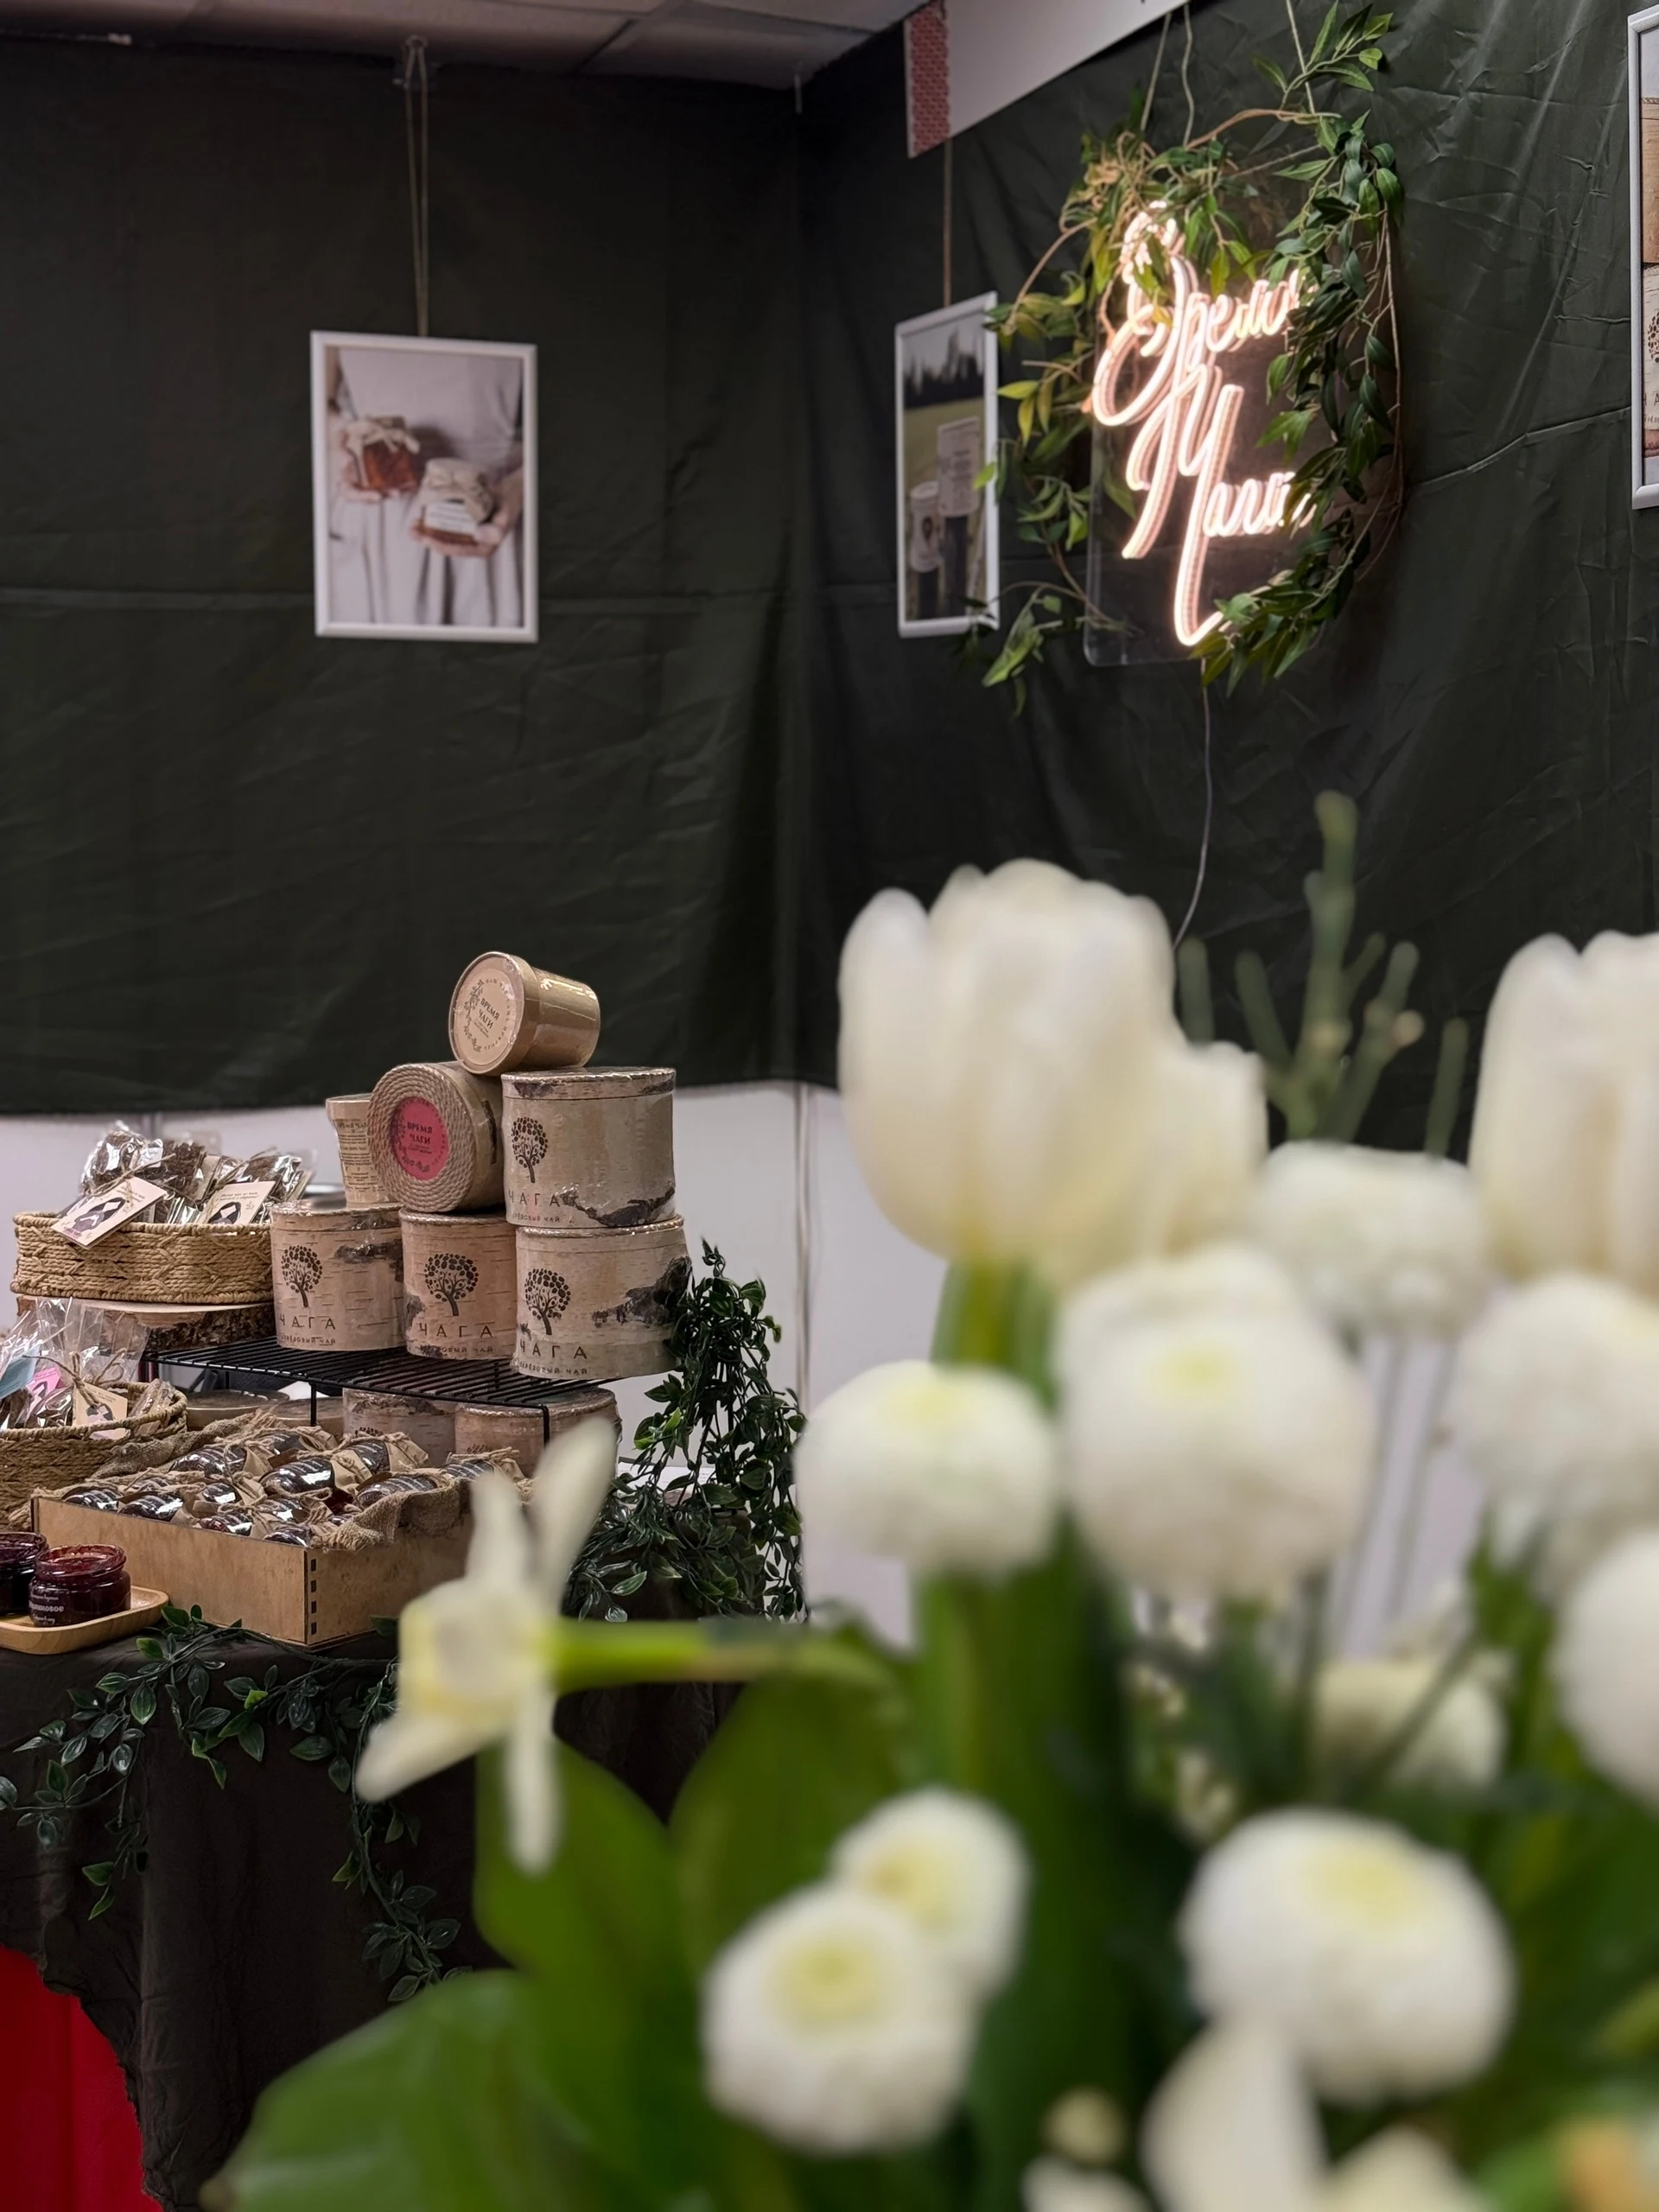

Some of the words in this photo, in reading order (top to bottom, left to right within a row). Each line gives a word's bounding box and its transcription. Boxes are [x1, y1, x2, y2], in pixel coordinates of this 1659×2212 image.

[480, 997, 500, 1020] ВРЕМЯ
[479, 1008, 493, 1029] ЧАГИ
[508, 1189, 561, 1208] ЧАГА
[279, 1313, 336, 1331] ЧАГА
[418, 1322, 493, 1338] ЧАГА
[519, 1339, 588, 1359] ЧАГА
[566, 1367, 588, 1376] ЧАЙ
